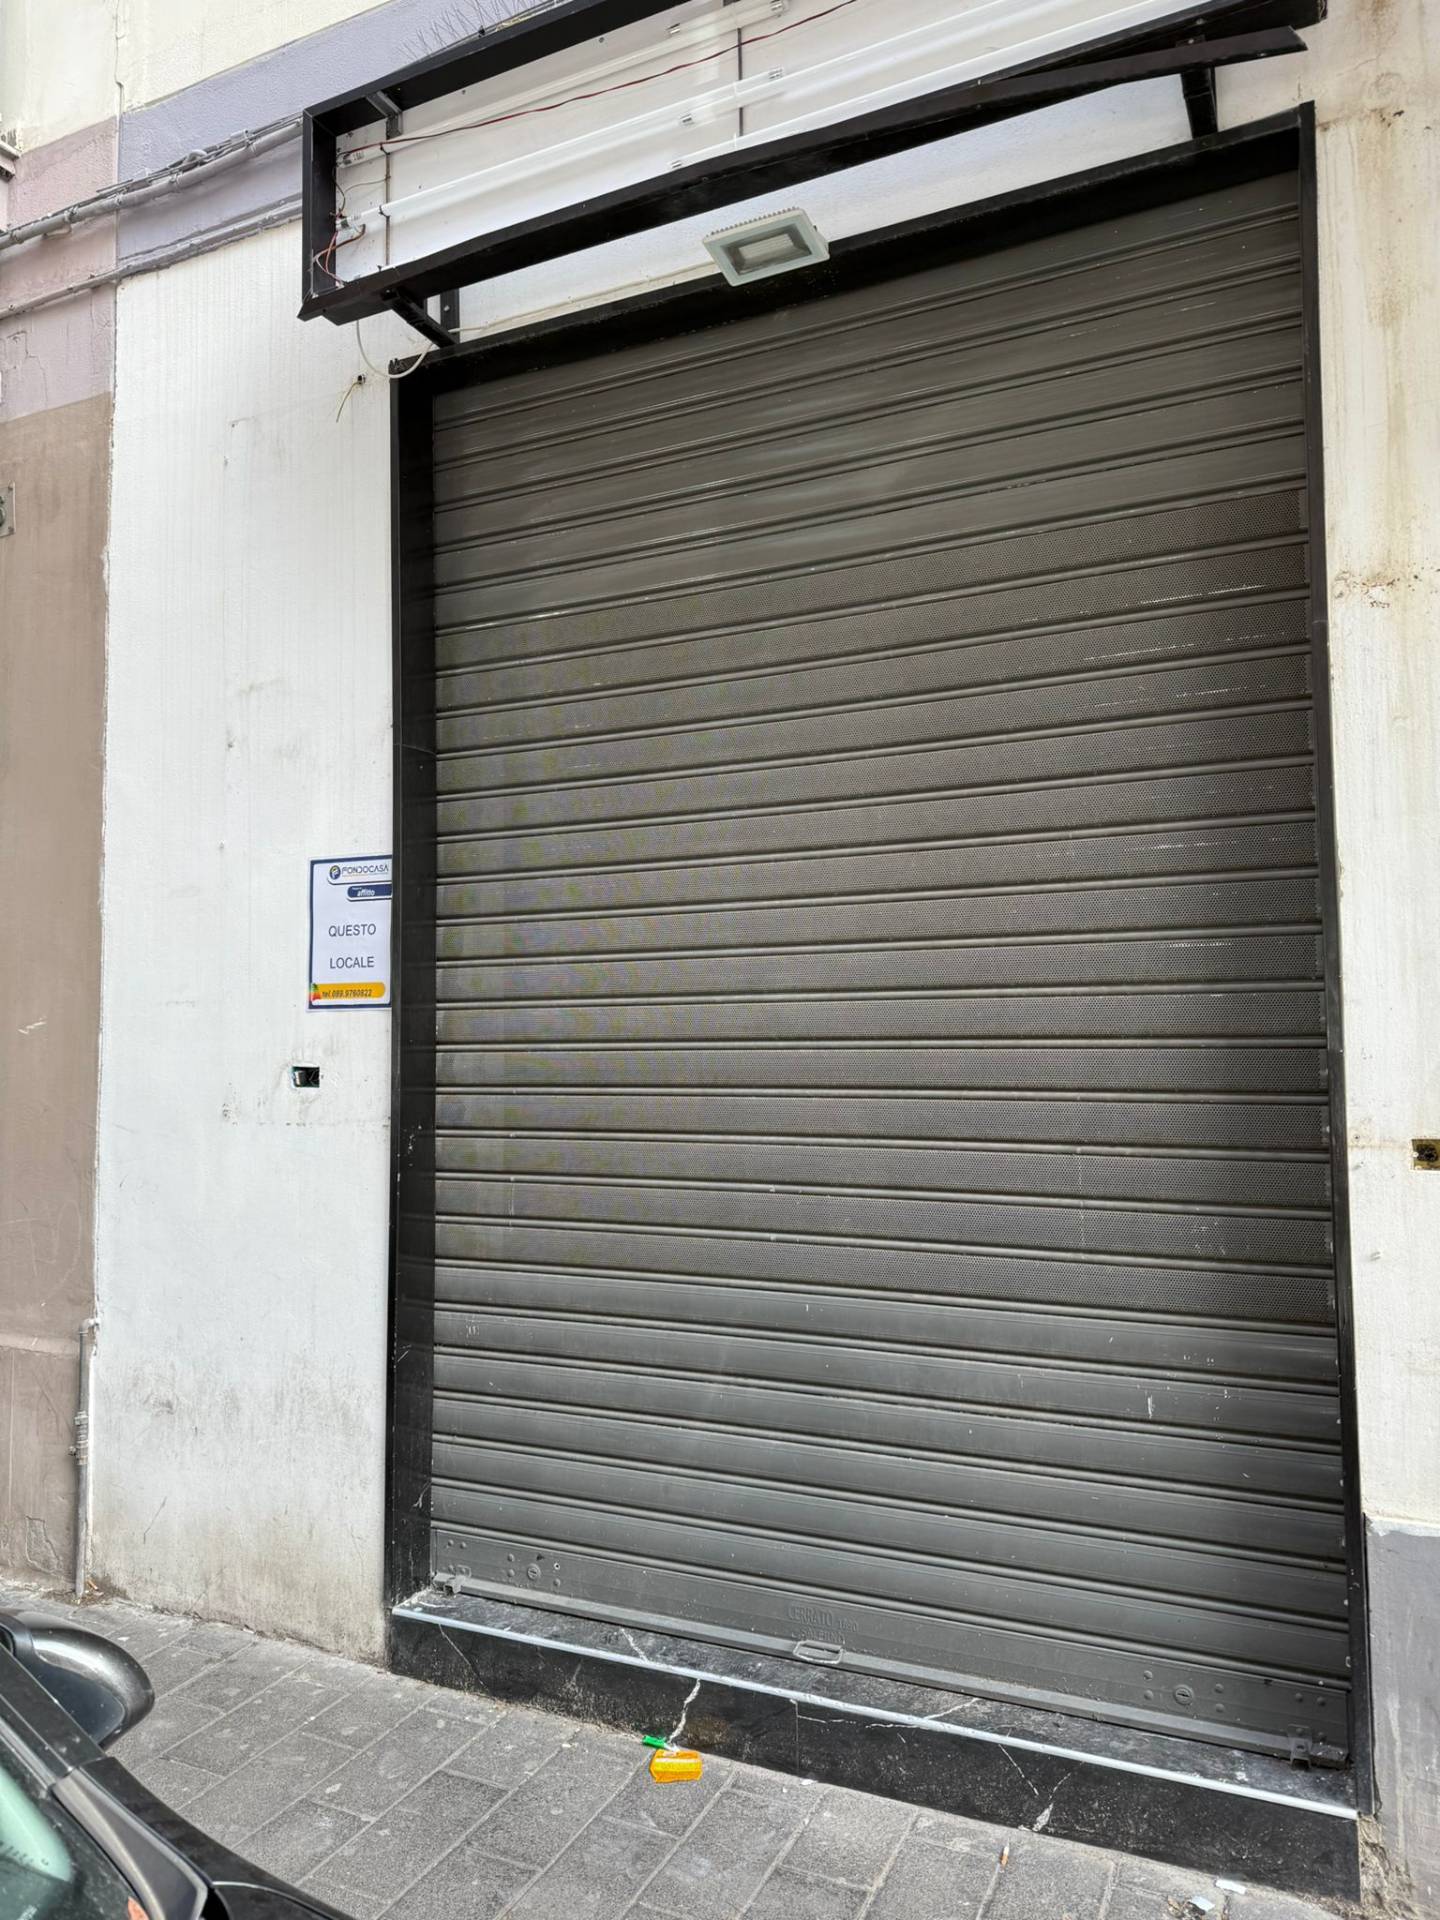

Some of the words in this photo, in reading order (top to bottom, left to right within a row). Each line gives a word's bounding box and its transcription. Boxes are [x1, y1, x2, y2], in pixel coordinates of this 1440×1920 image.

[342, 864, 388, 875] FONDOCASA
[328, 924, 376, 937] QUESTO
[330, 956, 375, 969] LOCALE
